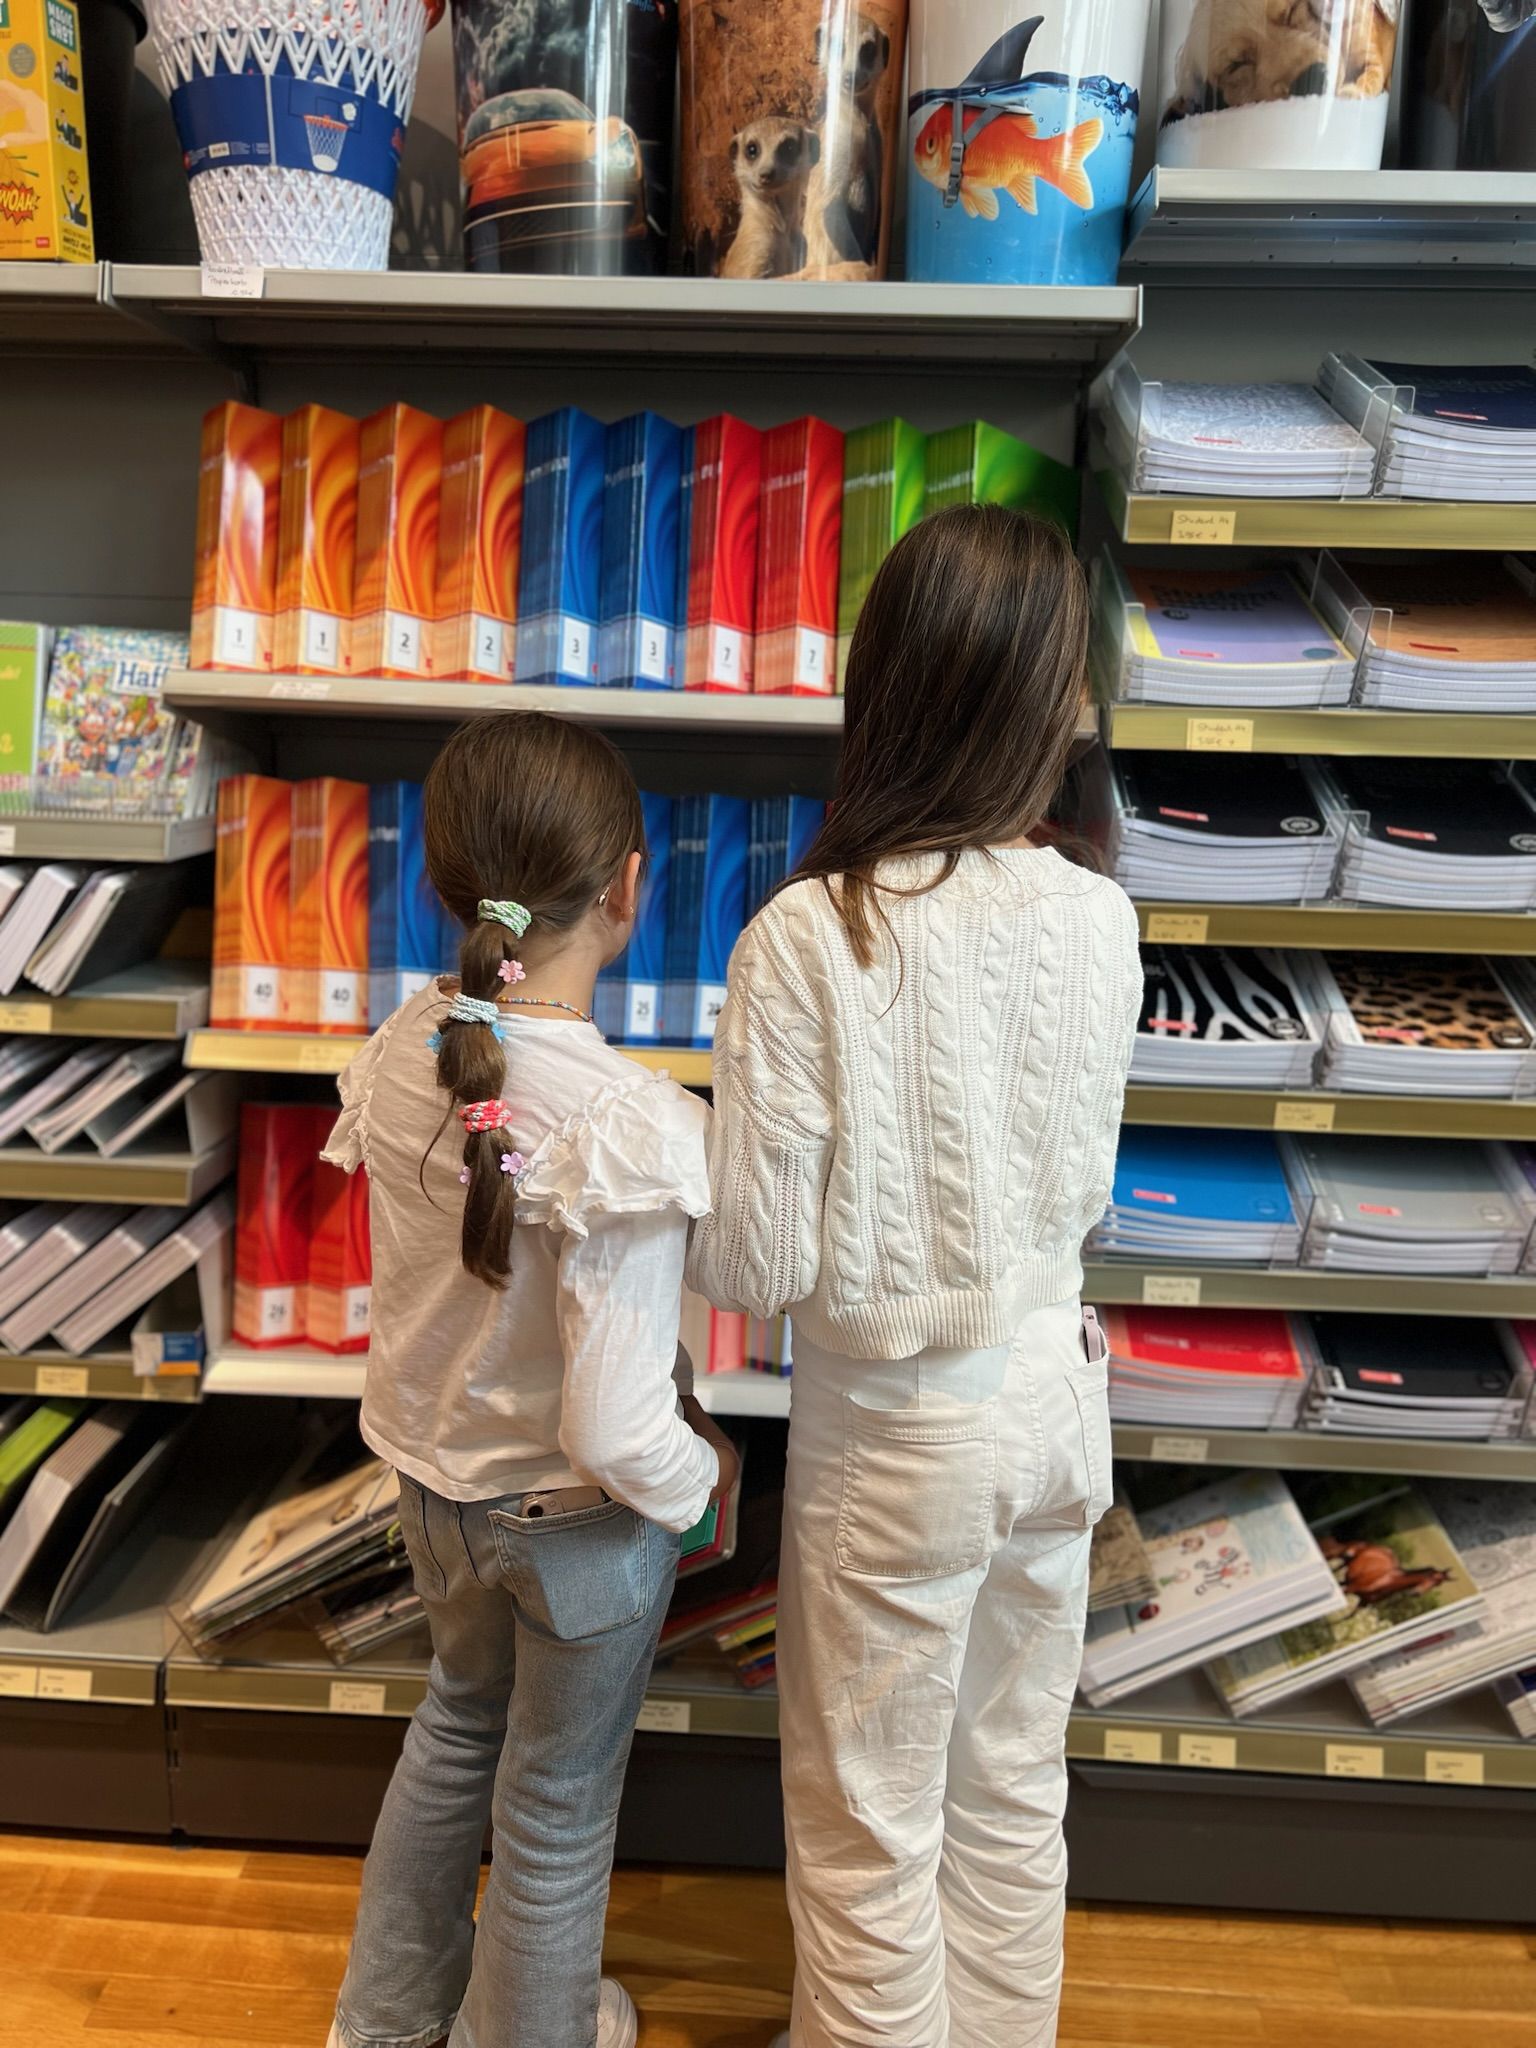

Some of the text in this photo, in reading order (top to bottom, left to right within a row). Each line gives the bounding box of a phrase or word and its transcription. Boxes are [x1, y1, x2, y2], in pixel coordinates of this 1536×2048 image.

[236, 628, 242, 643] 1
[320, 631, 326, 647] 1
[401, 632, 410, 648] 2
[485, 635, 494, 651] 2
[573, 637, 580, 654] 3
[650, 641, 657, 656] 3
[724, 646, 731, 662] 7
[809, 648, 816, 664] 7
[255, 983, 273, 998] 40
[332, 987, 350, 1002] 40
